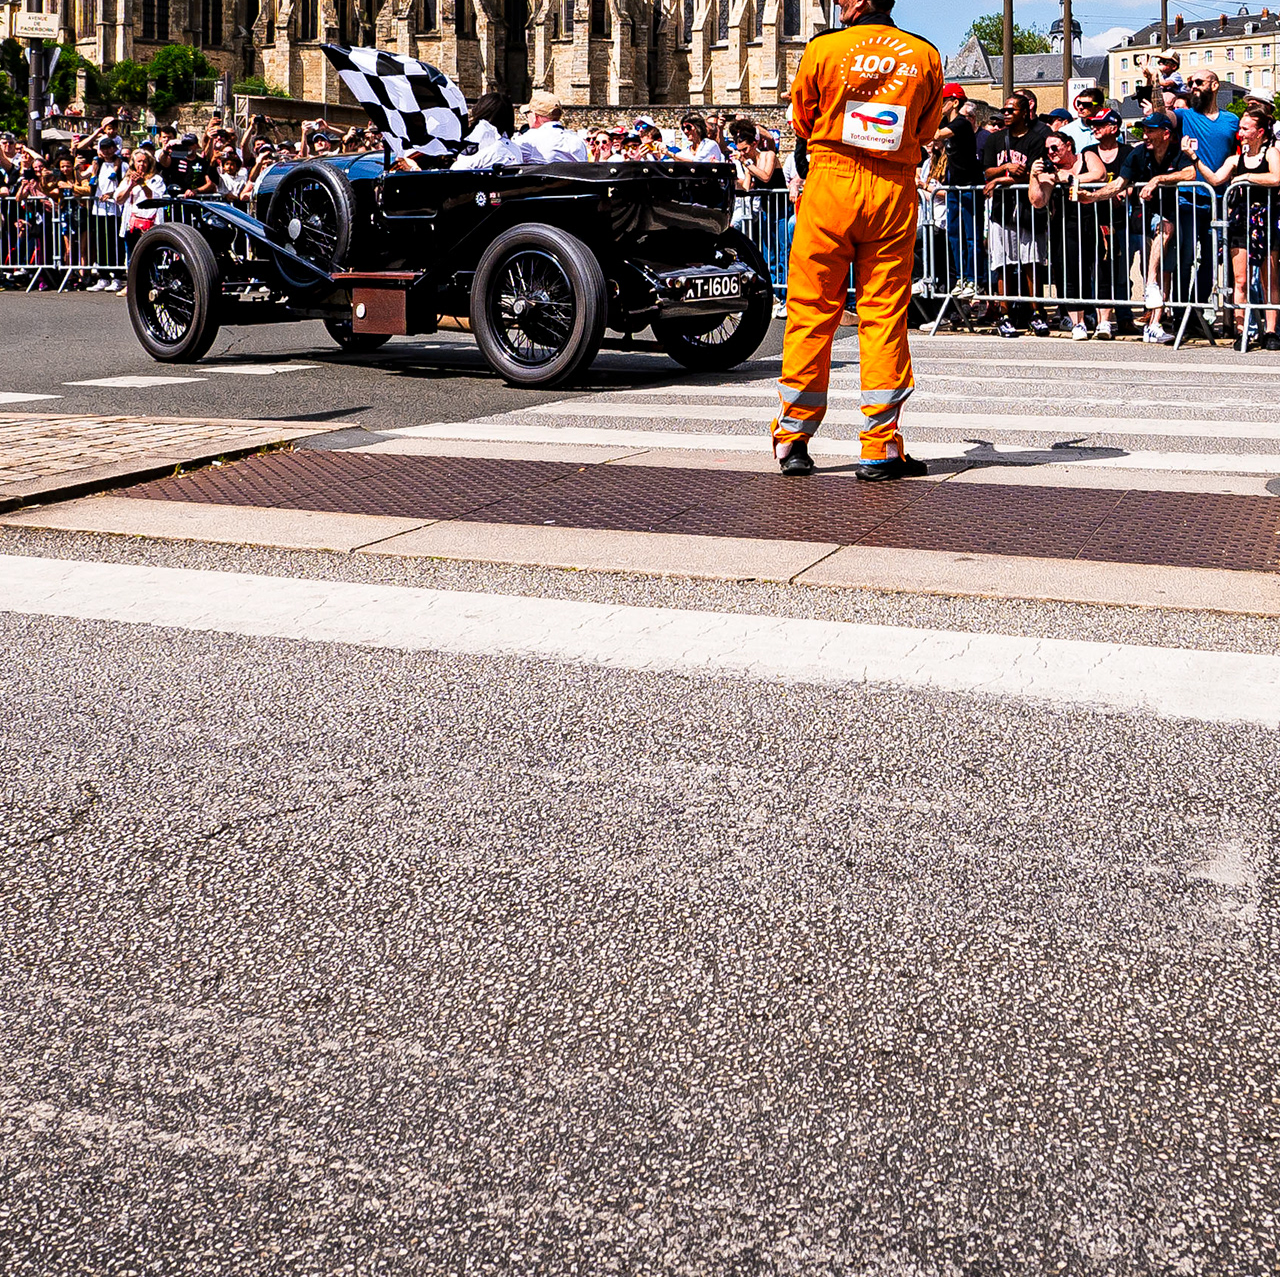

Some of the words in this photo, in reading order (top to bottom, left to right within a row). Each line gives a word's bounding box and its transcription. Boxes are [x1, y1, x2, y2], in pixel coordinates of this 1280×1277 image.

[850, 54, 896, 74] 100
[1073, 82, 1089, 90] ZONE
[850, 133, 895, 145] TotalEnergies
